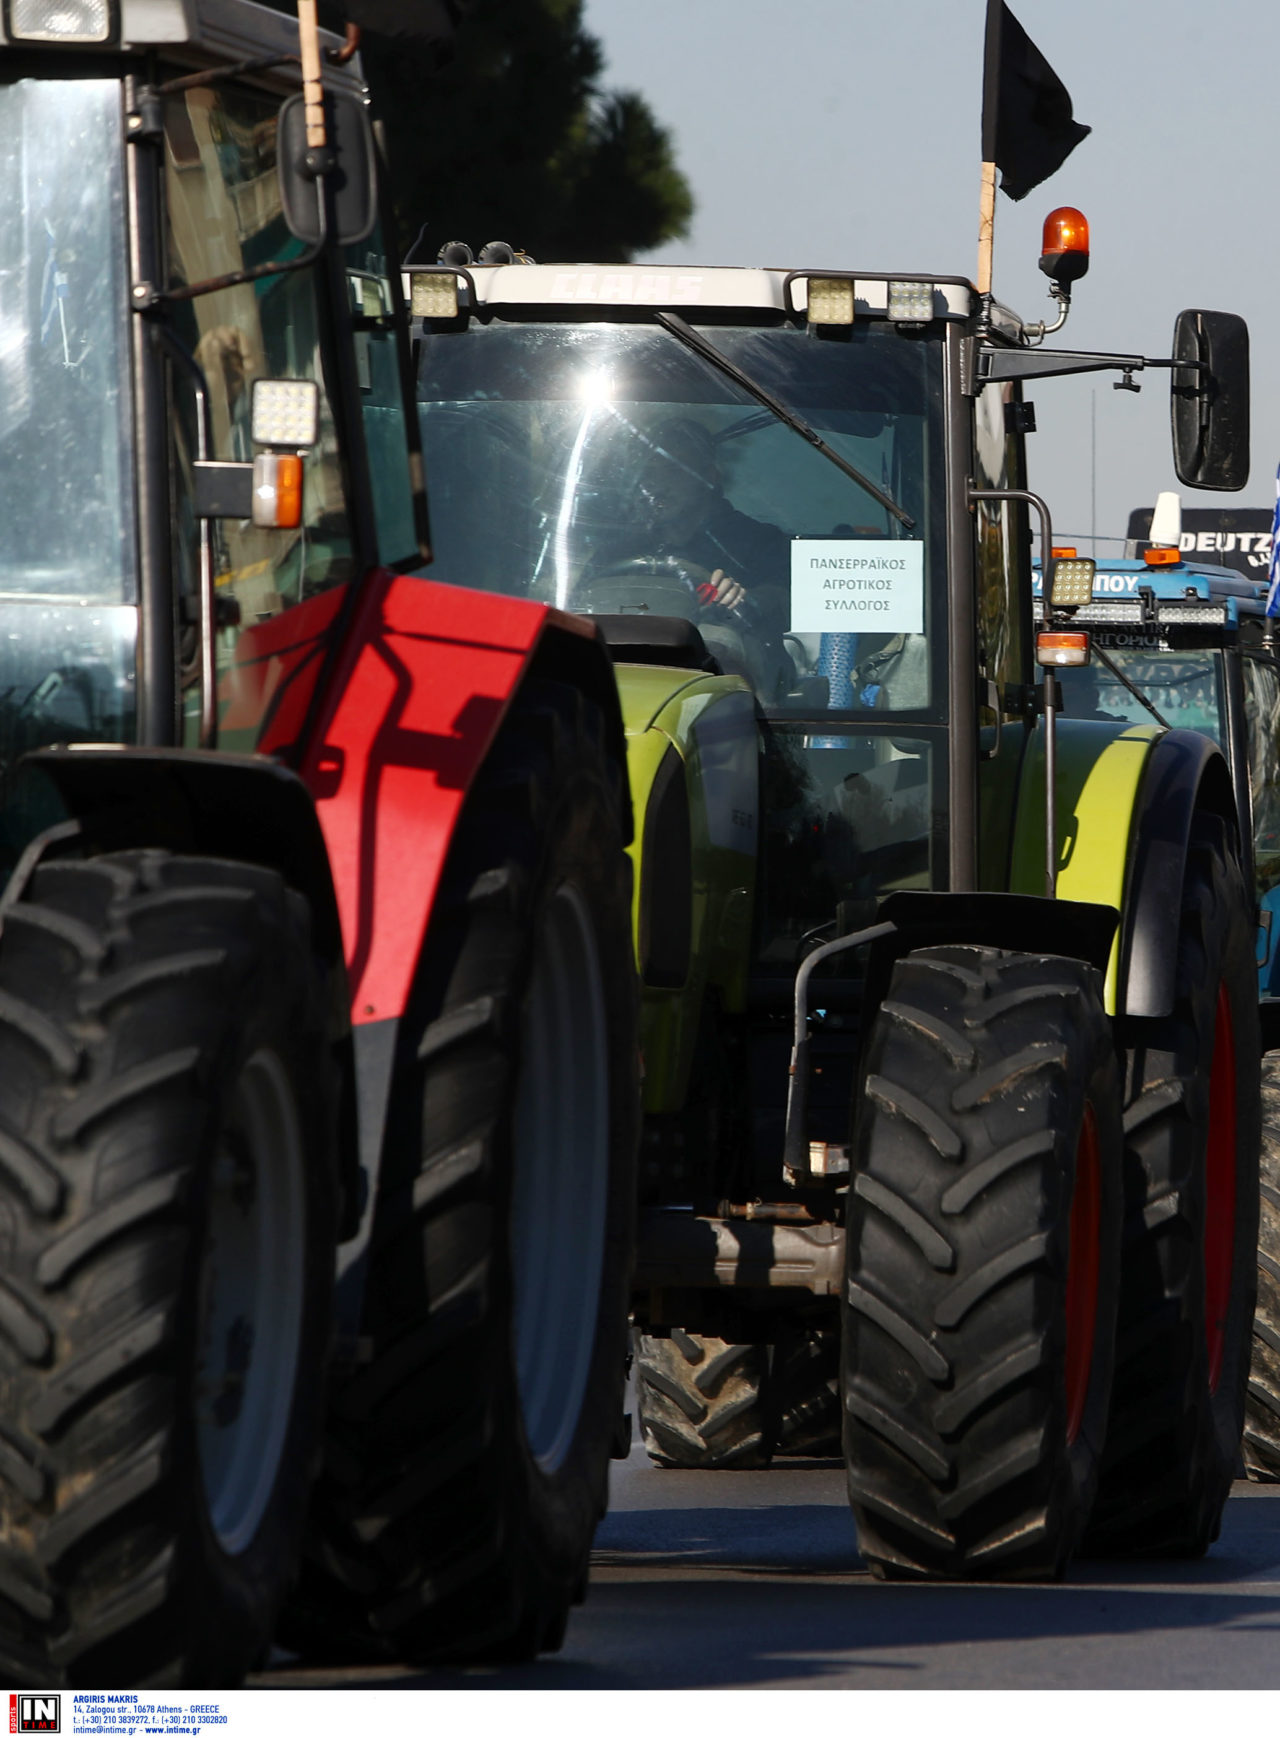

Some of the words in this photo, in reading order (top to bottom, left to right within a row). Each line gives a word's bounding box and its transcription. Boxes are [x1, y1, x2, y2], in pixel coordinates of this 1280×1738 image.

[549, 273, 704, 301] CLAAS
[810, 556, 906, 570] ΠΑΝΣΕΡΡΑΪΚΟΣ
[822, 579, 893, 590] ΑΓΡΟΤΙΚΟΣ
[824, 599, 891, 611] ΣΥΛΛΟΓΟΣ
